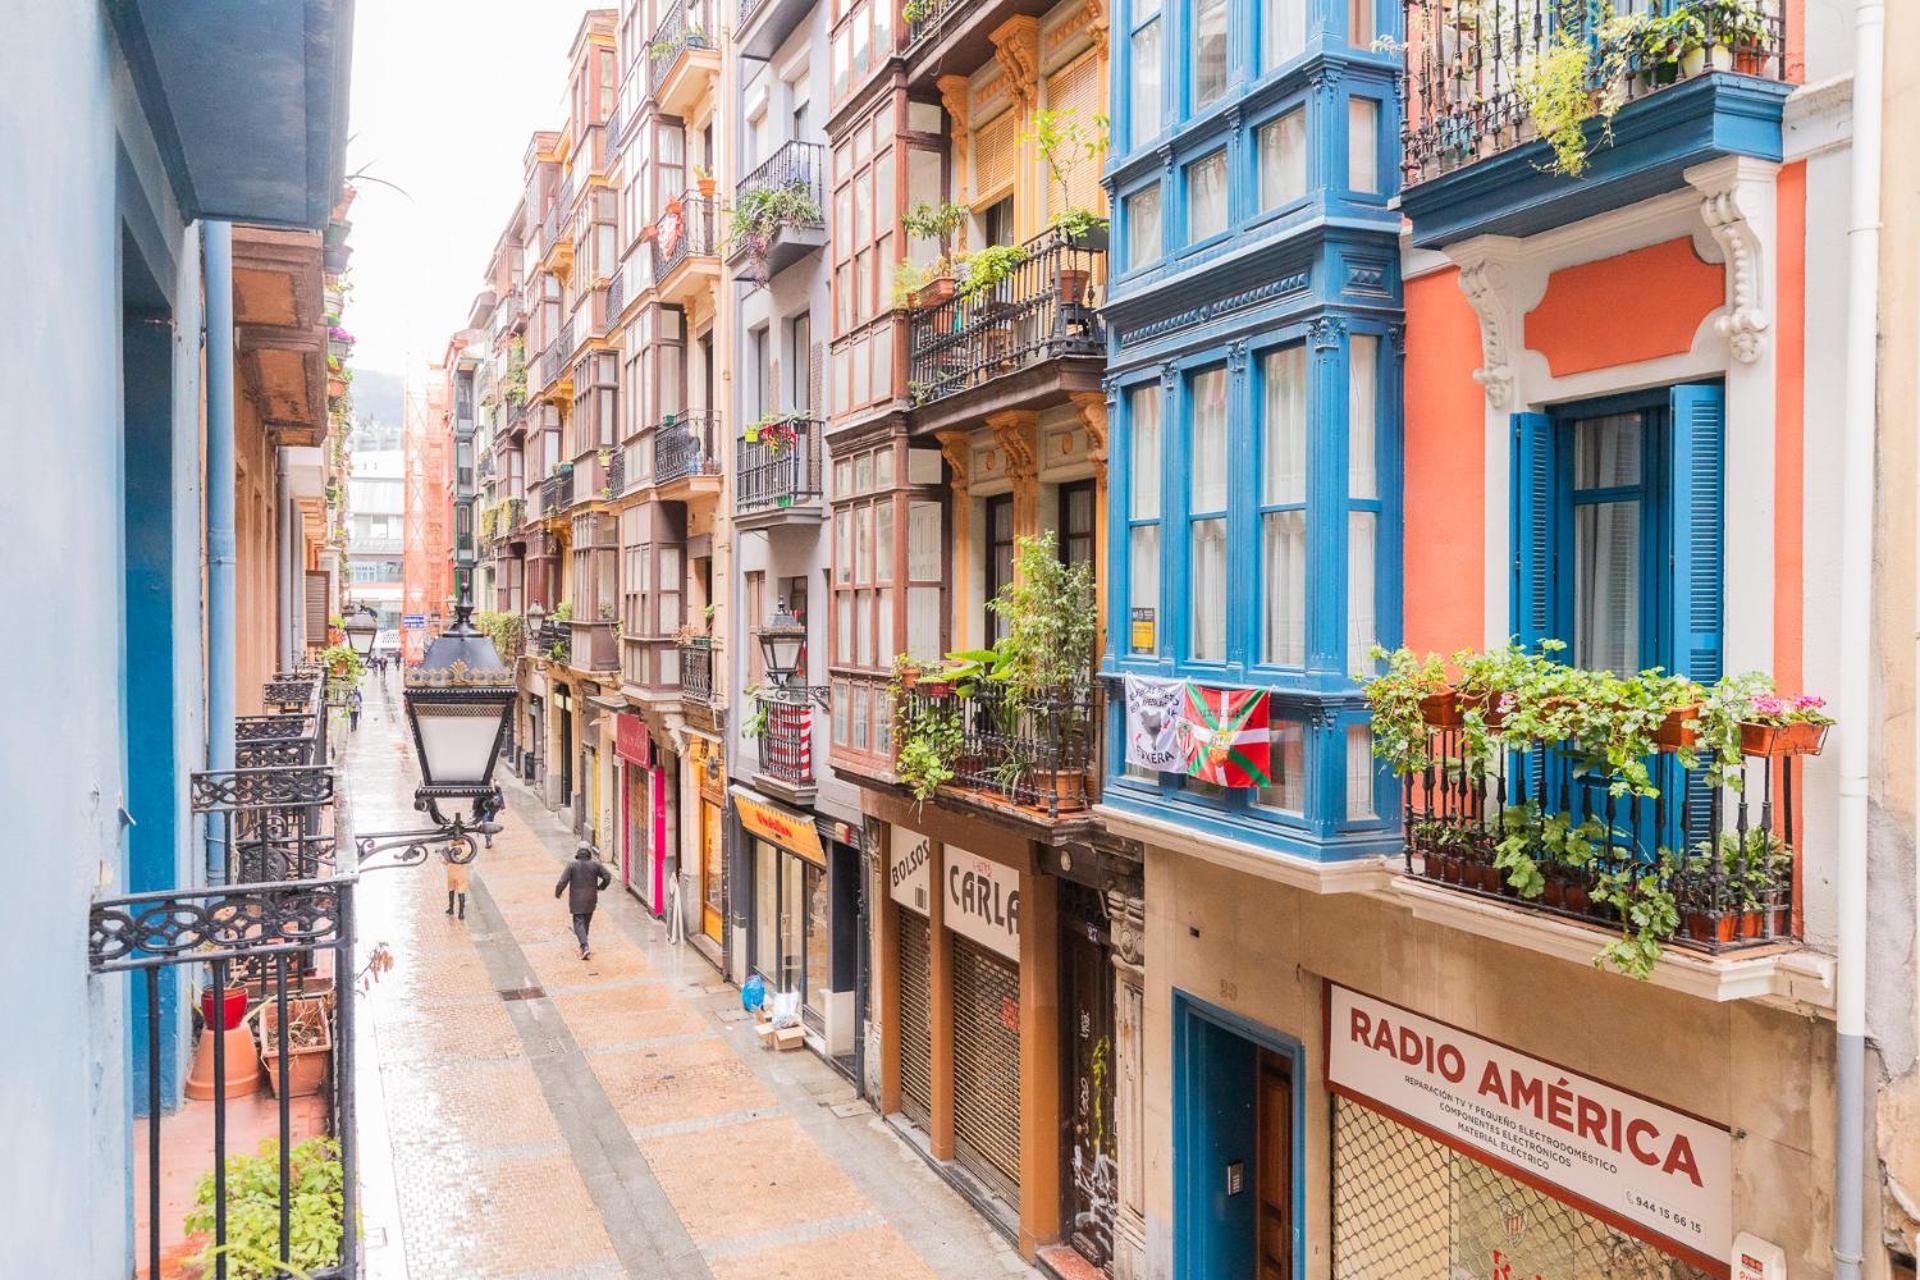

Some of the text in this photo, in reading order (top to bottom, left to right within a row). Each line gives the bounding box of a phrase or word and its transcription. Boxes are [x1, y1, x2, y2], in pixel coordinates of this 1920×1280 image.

[892, 840, 929, 887] BOLSOS
[950, 865, 1020, 935] CARLA
[1351, 1007, 1704, 1188] RADIO AMÉRICA
[1404, 1075, 1618, 1174] REPARACIÓN TV Y PEQUEÑO ELECTRODOMÉSTICO
[1439, 1102, 1572, 1167] COMPONENTES ELECTRÓNICOS
[1457, 1121, 1550, 1170] MATERIAL ELÉCTRICO
[1635, 1196, 1702, 1233] 944 15 66 15
